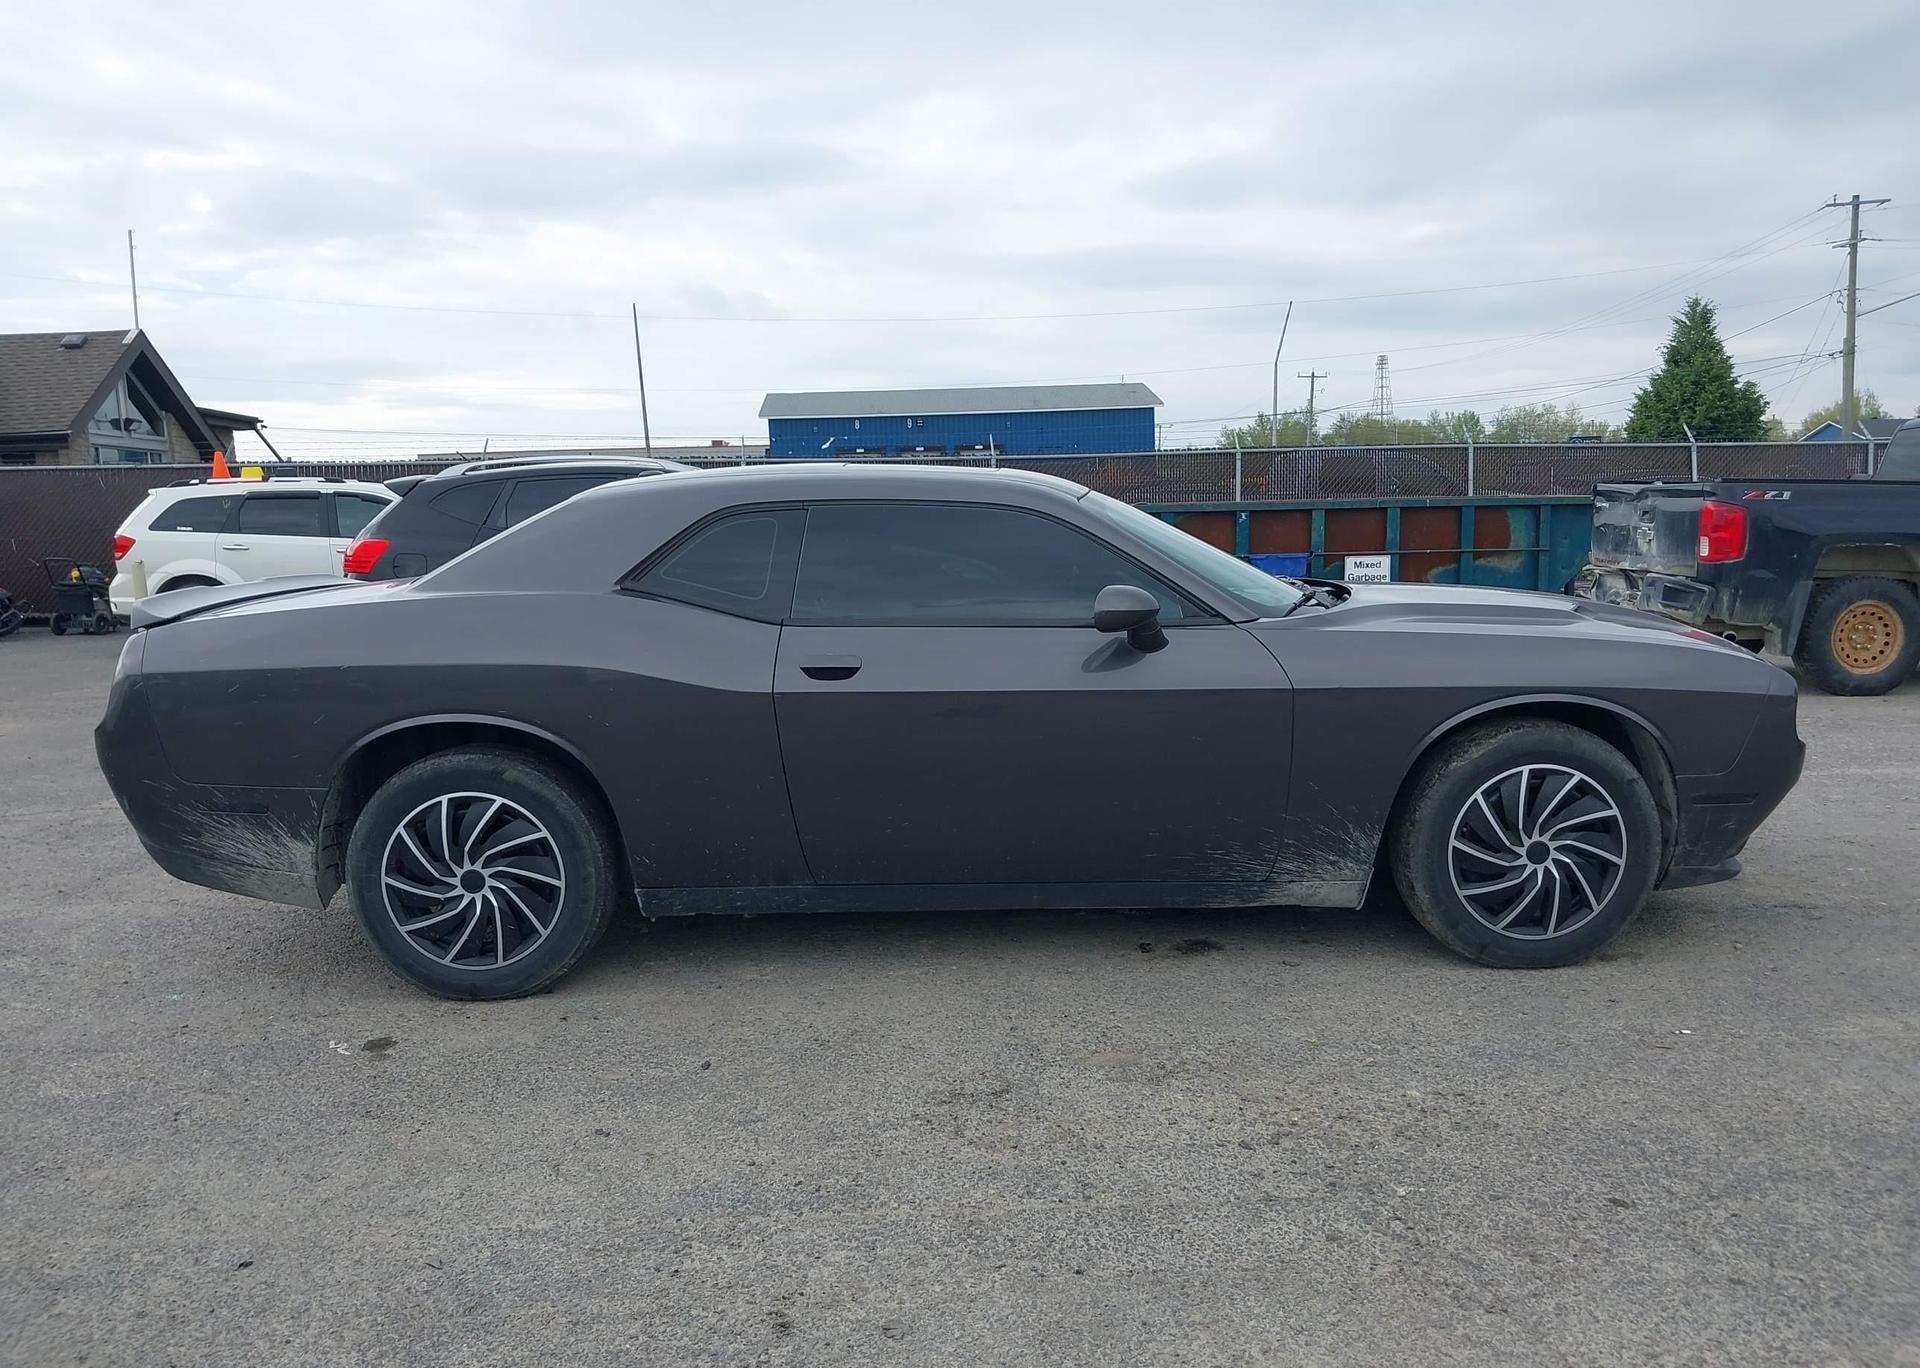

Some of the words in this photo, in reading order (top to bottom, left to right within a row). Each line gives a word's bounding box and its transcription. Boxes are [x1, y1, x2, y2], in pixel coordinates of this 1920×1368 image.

[854, 419, 860, 430] 8
[906, 417, 913, 429] 9
[1353, 561, 1382, 569] Mixed
[1347, 573, 1388, 583] Garbage
